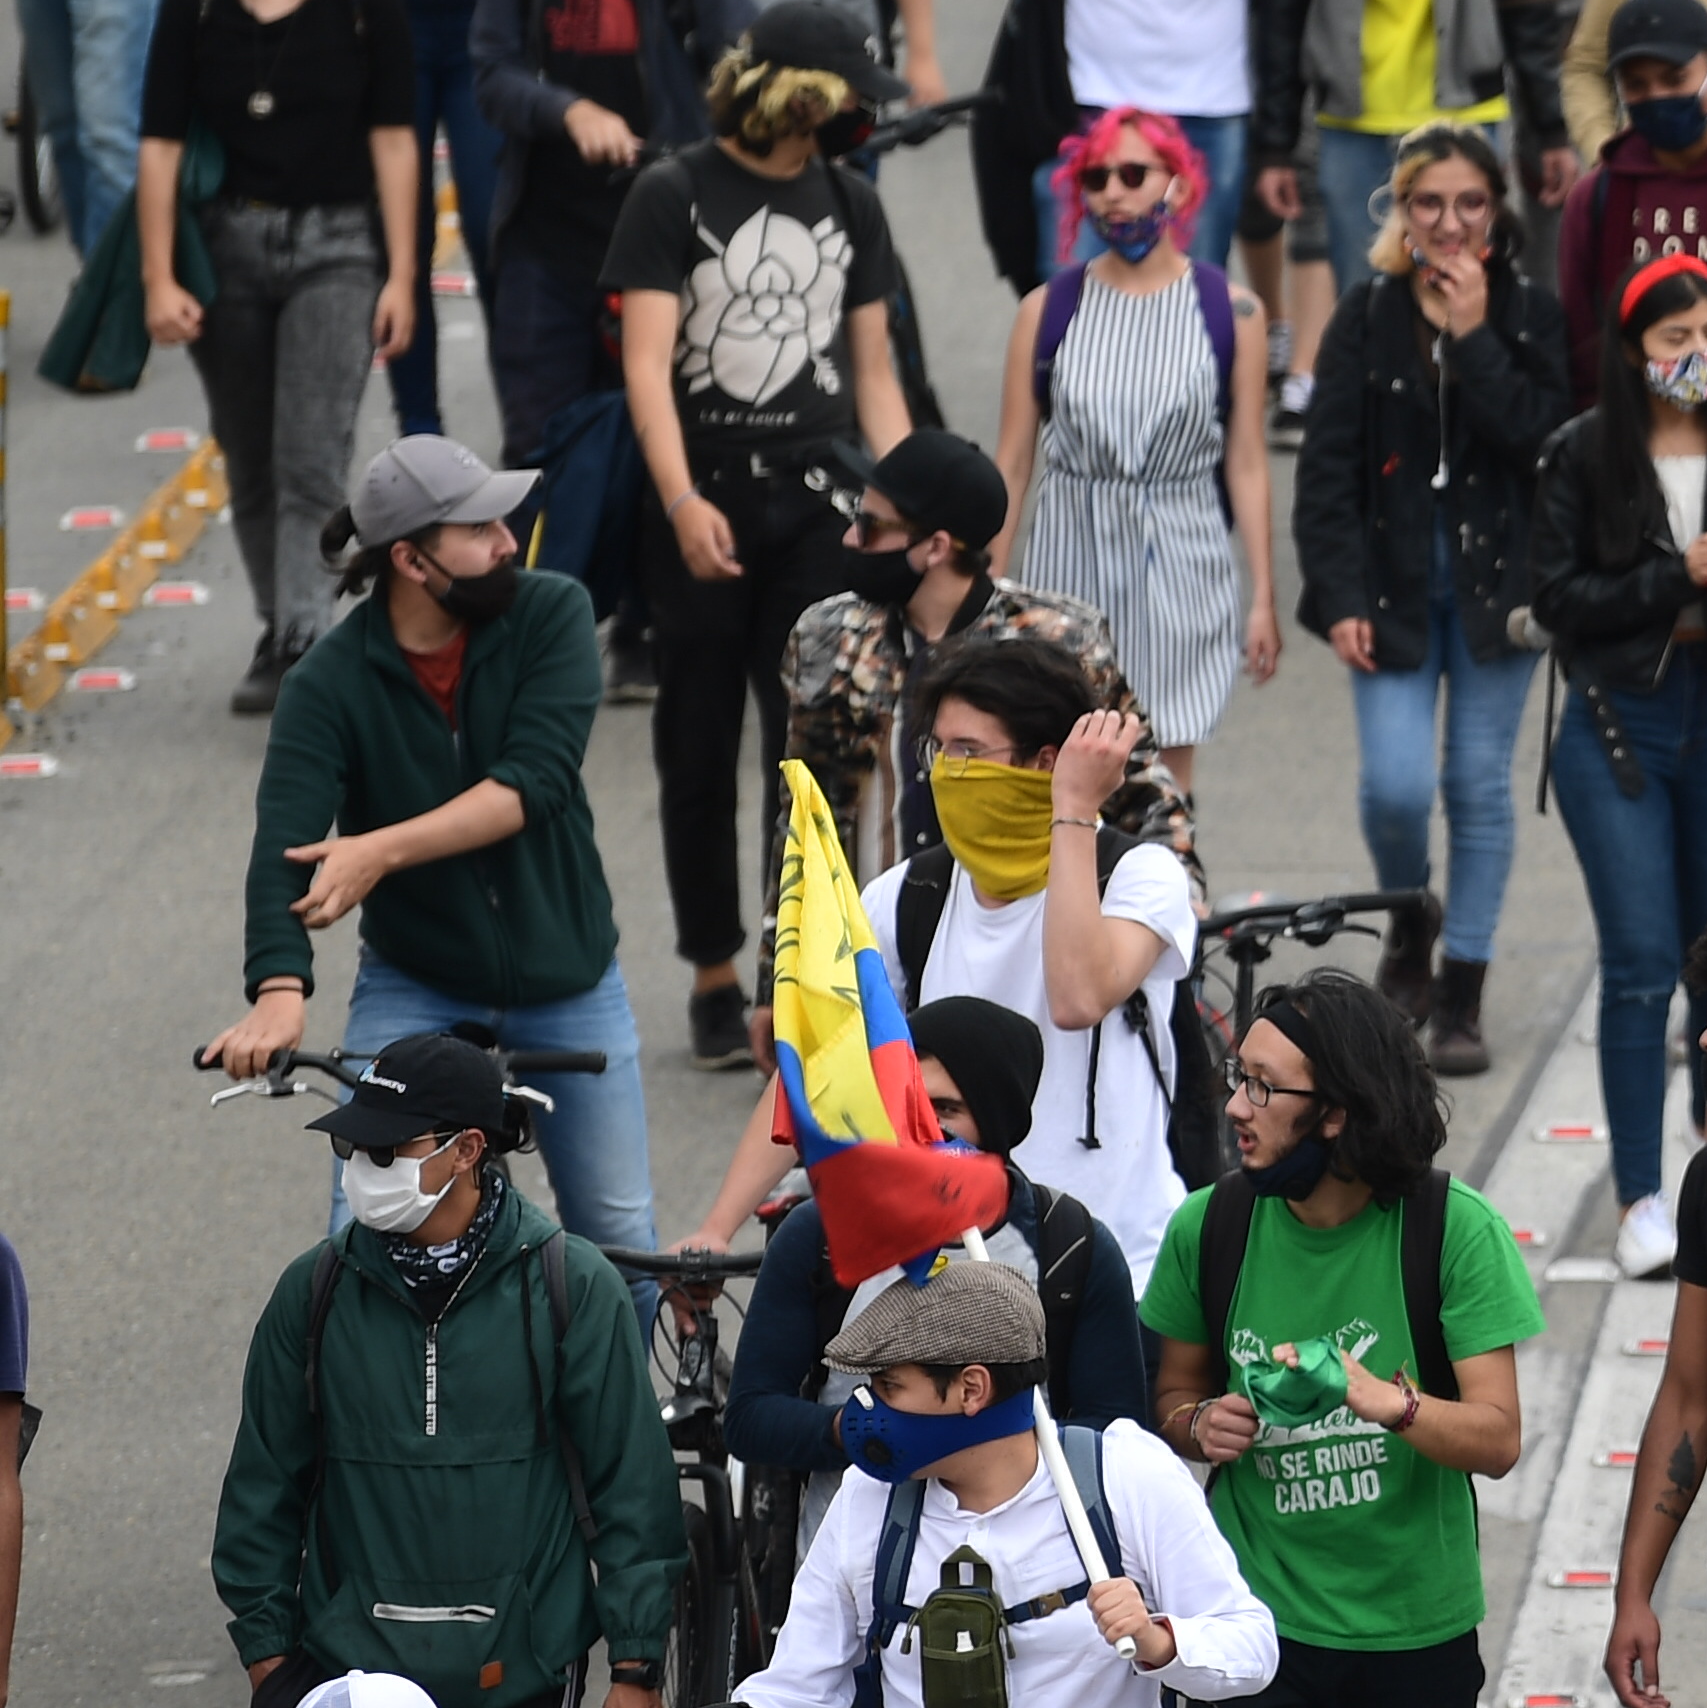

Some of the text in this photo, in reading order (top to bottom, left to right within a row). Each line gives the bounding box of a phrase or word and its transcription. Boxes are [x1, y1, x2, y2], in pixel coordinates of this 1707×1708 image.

[1280, 1451, 1310, 1480] SE
[1315, 1437, 1388, 1475] RINDE
[1275, 1469, 1381, 1514] CARAJO
